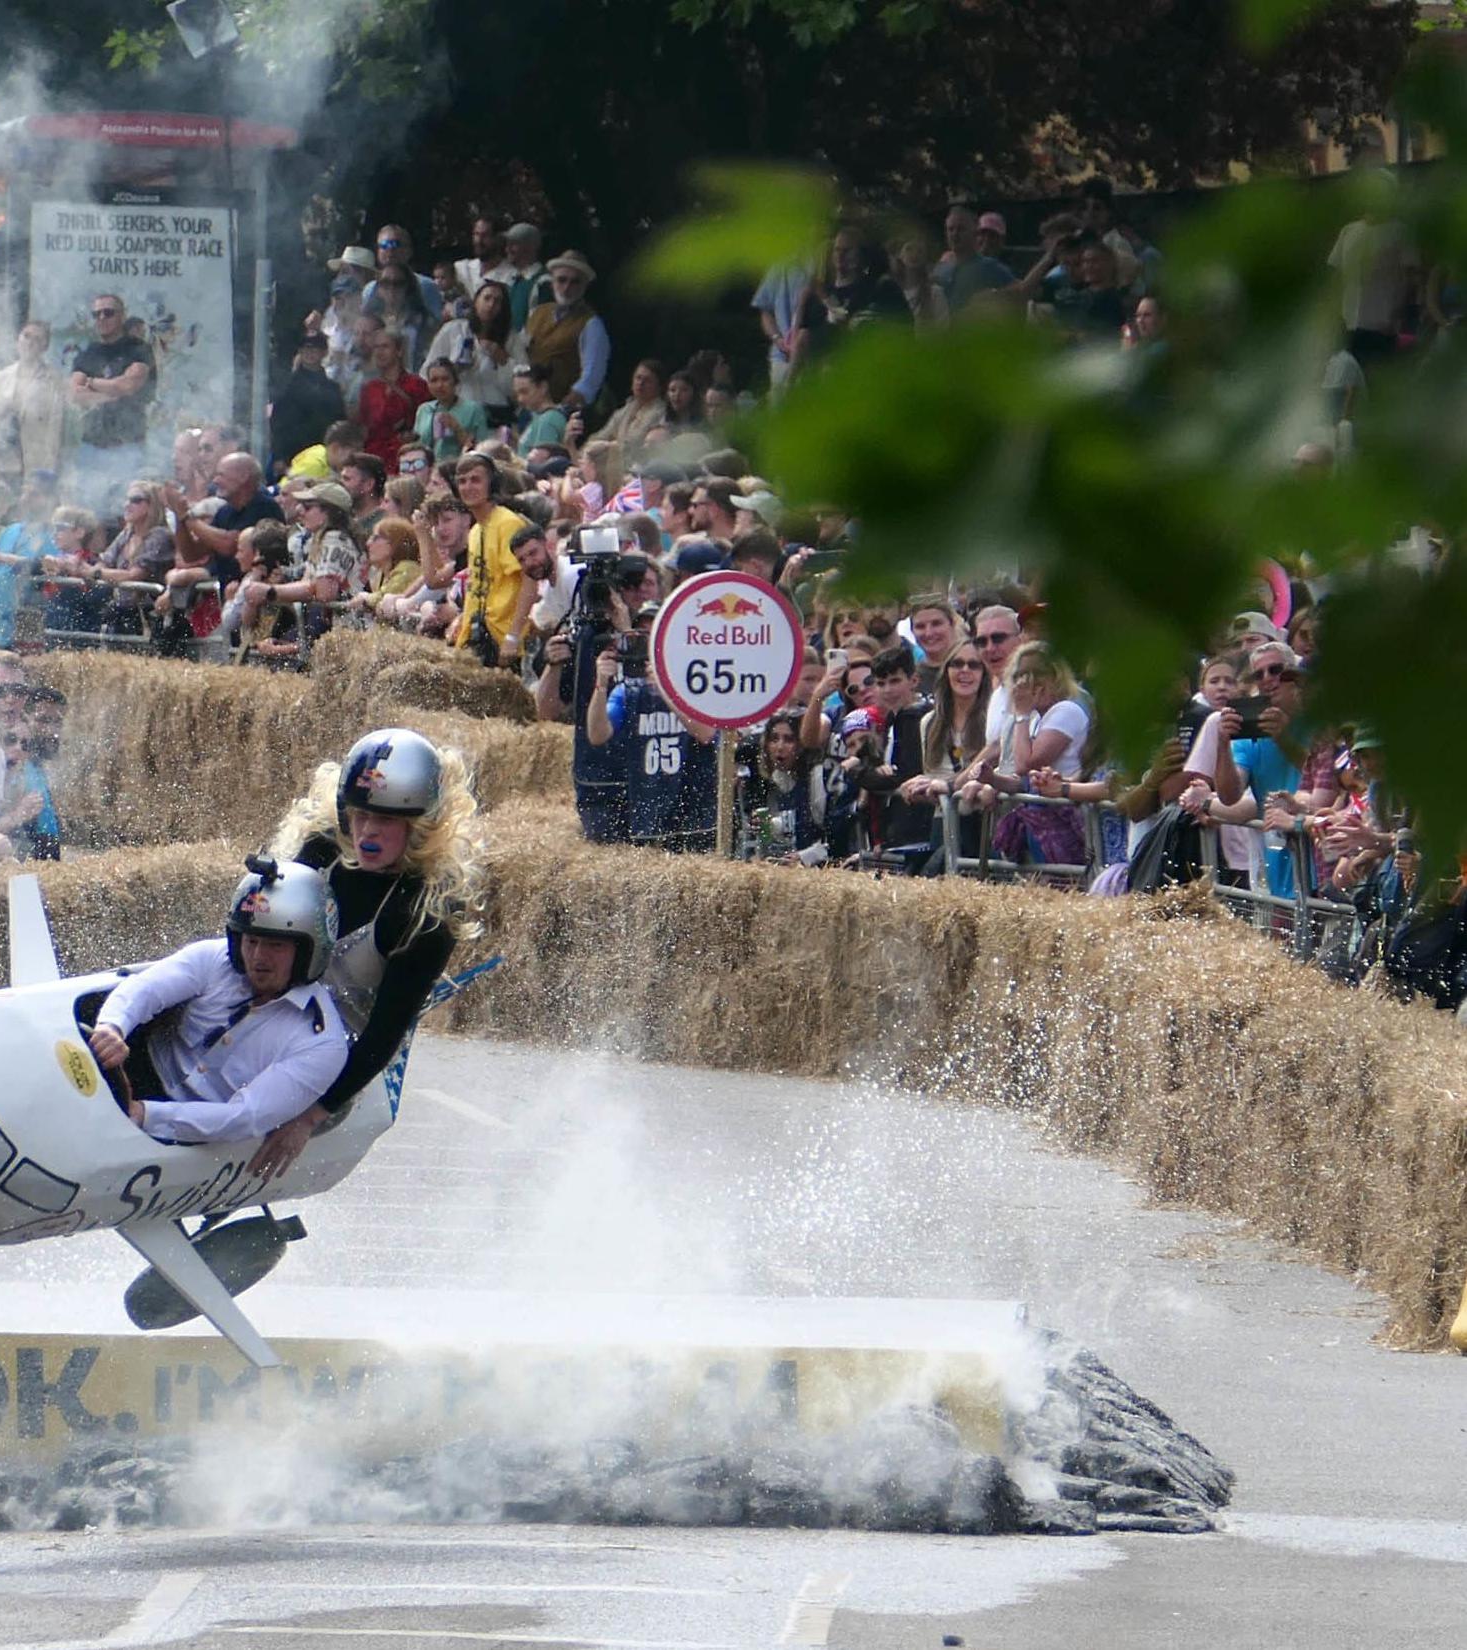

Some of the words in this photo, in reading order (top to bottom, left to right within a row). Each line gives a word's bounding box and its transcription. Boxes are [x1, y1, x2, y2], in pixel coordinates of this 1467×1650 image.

[57, 212, 102, 230] THRILL
[172, 216, 212, 235] YOUR
[45, 233, 73, 250] RED
[77, 234, 109, 252] BULL
[115, 236, 183, 255] SOAPBOX
[187, 239, 224, 258] RACE
[88, 257, 139, 275] STARTS
[686, 625, 727, 645] Red
[732, 624, 771, 646] Bull
[686, 659, 767, 695] 65m
[644, 737, 682, 776] 65
